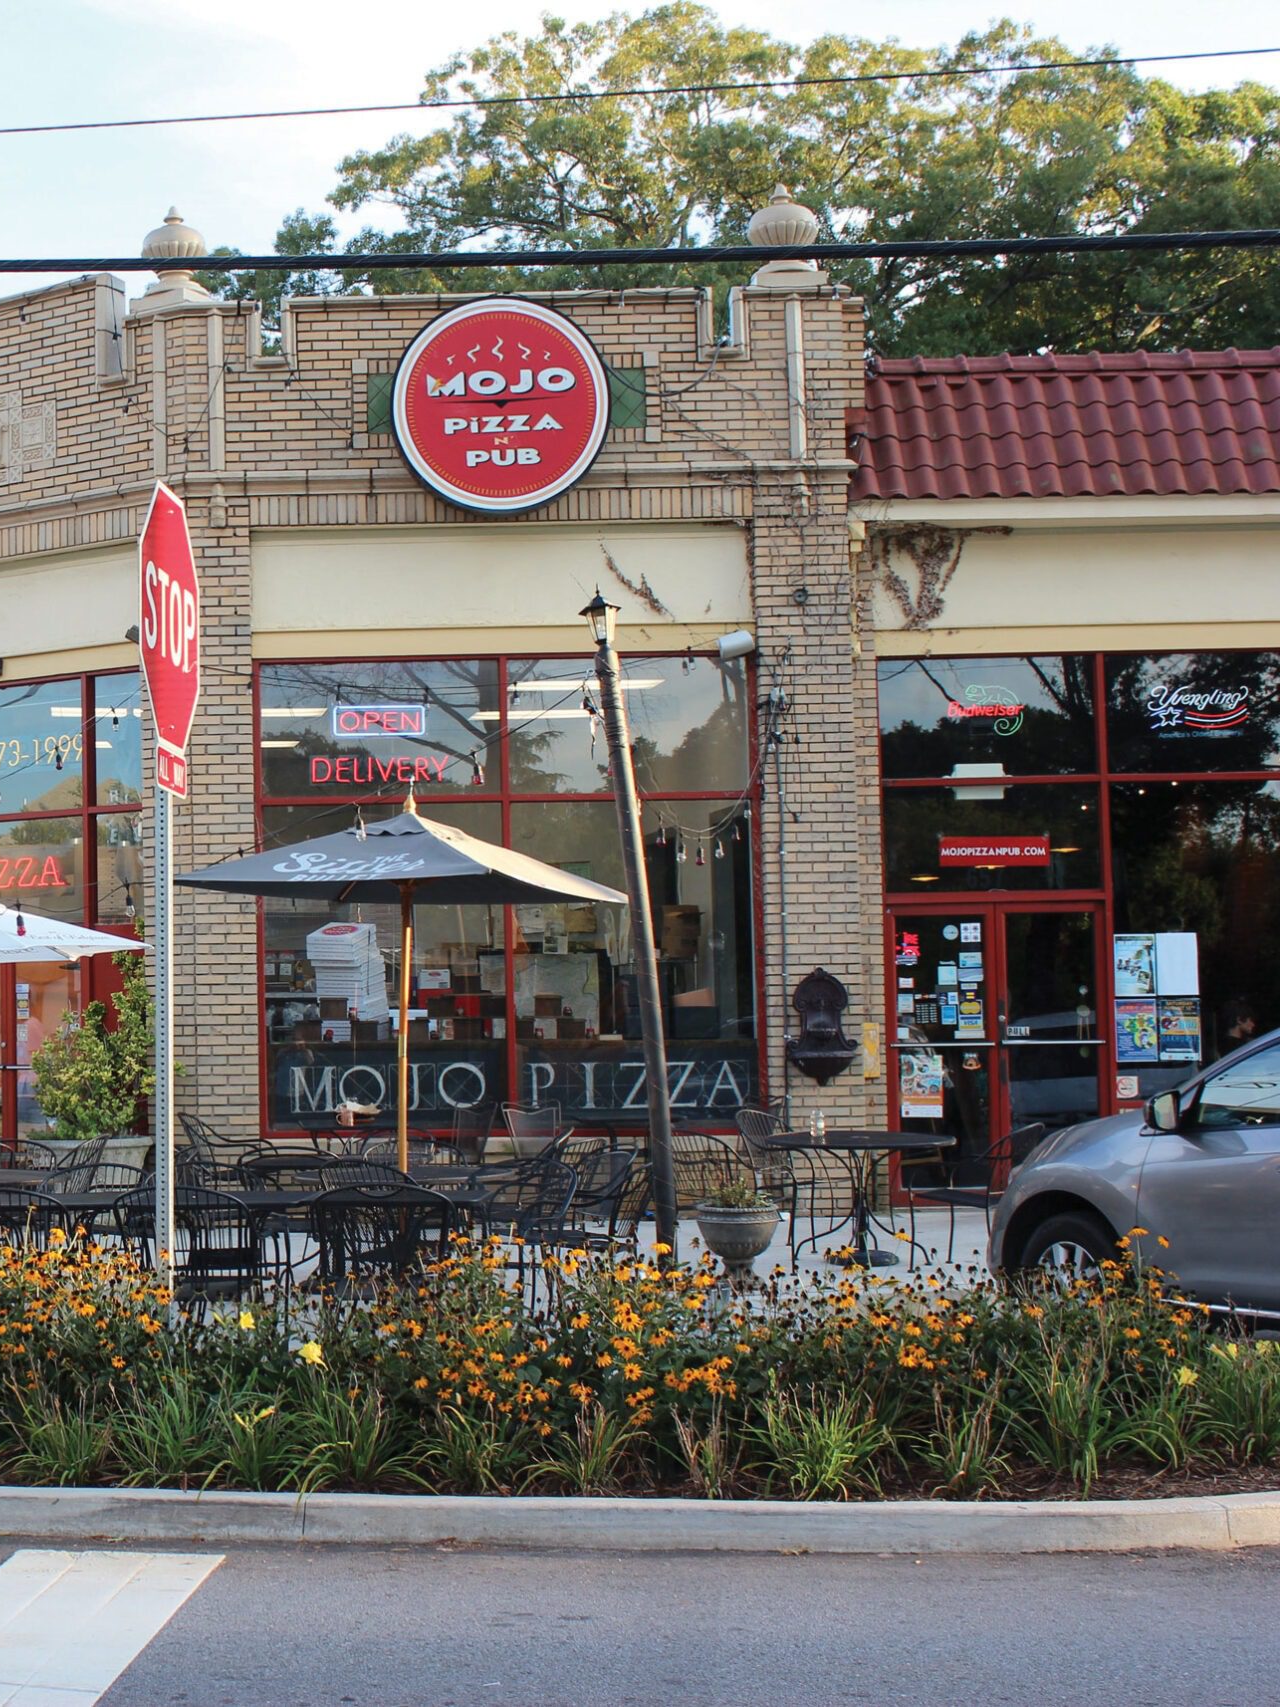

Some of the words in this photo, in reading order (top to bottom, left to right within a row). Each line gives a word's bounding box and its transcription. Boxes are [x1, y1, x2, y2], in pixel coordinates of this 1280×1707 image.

[426, 367, 576, 397] MOJO
[465, 448, 542, 467] PUB
[144, 560, 196, 673] STOP
[948, 701, 1024, 717] Budweiser
[1147, 685, 1249, 711] Yuengling
[339, 711, 420, 732] OPEN
[159, 754, 169, 781] ALL
[173, 761, 184, 788] WAY
[311, 755, 449, 783] DELIVERY
[940, 847, 1046, 856] MOJOPIZZANPUB.COM
[1008, 1027, 1029, 1036] PULL
[291, 1061, 486, 1113] MOJO
[524, 1059, 744, 1109] PIZZA
